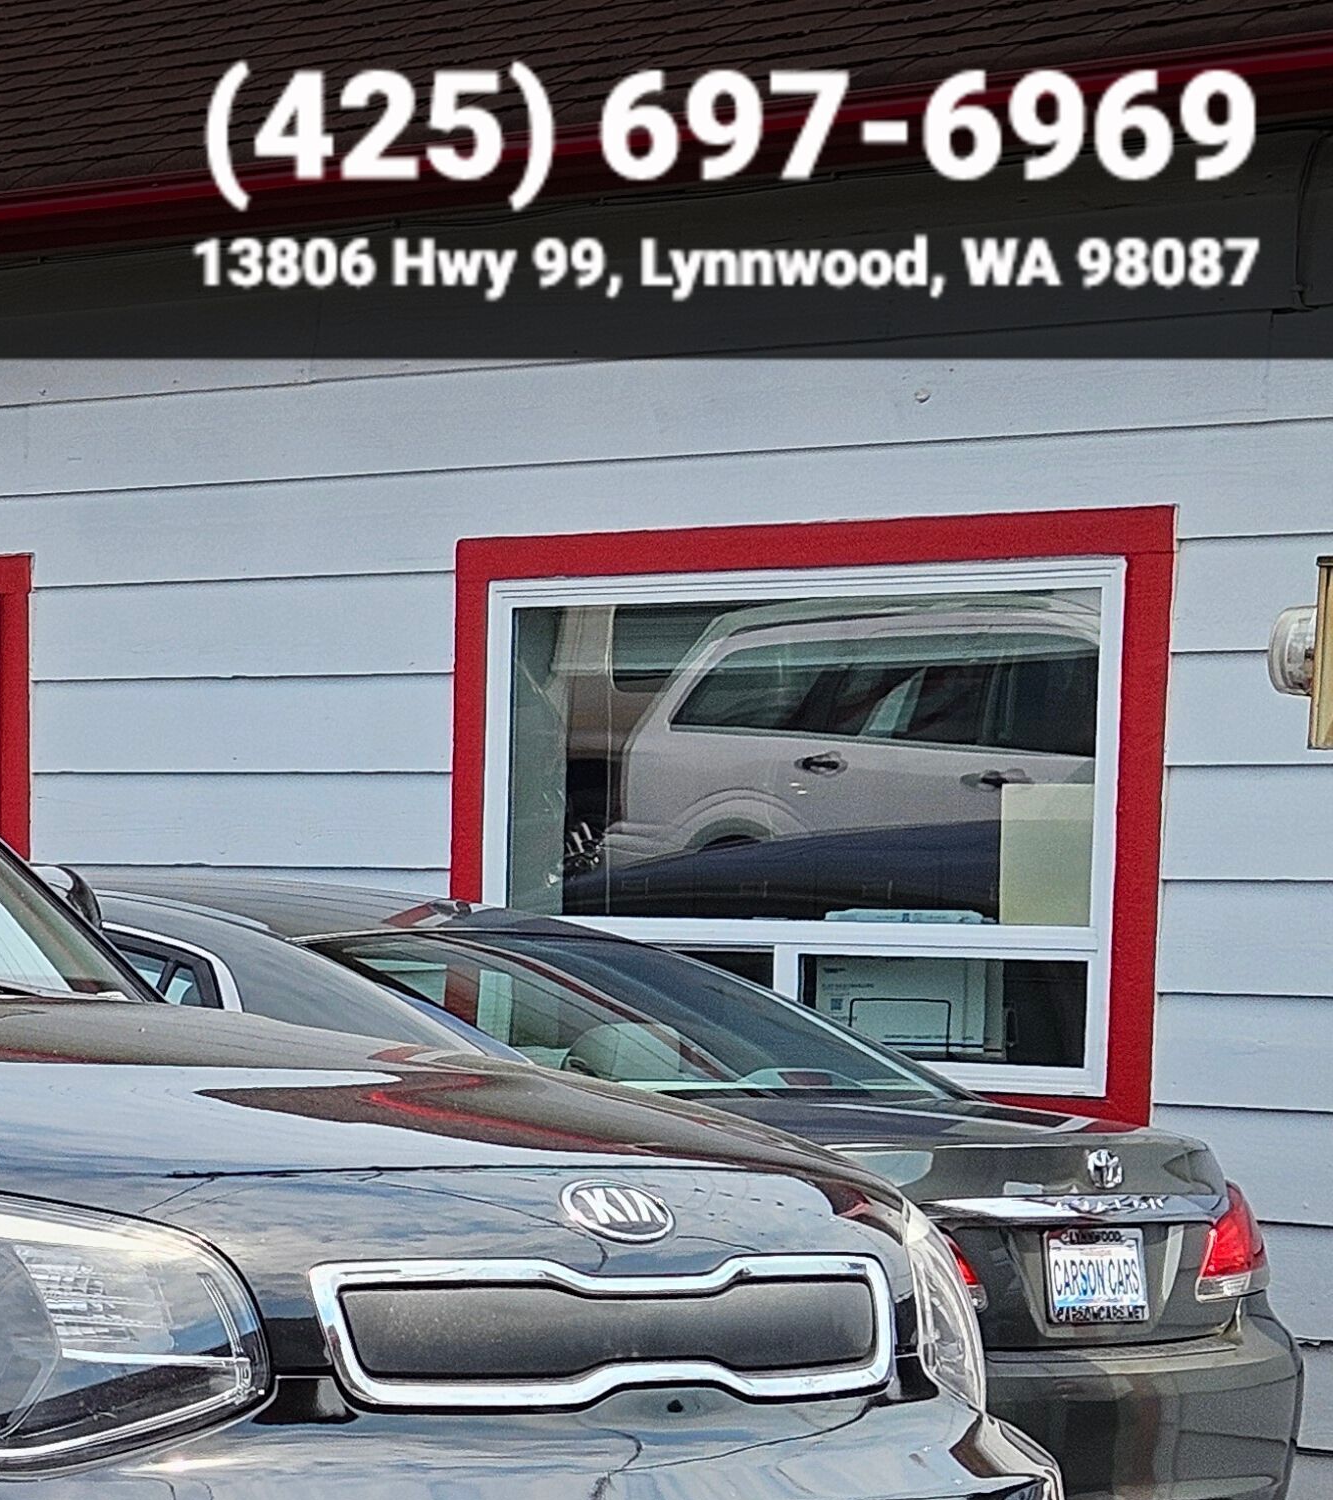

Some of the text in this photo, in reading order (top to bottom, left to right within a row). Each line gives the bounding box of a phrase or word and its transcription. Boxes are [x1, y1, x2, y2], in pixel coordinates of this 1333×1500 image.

[576, 1187, 667, 1225] KIA
[1053, 1258, 1140, 1297] CARSON CARS
